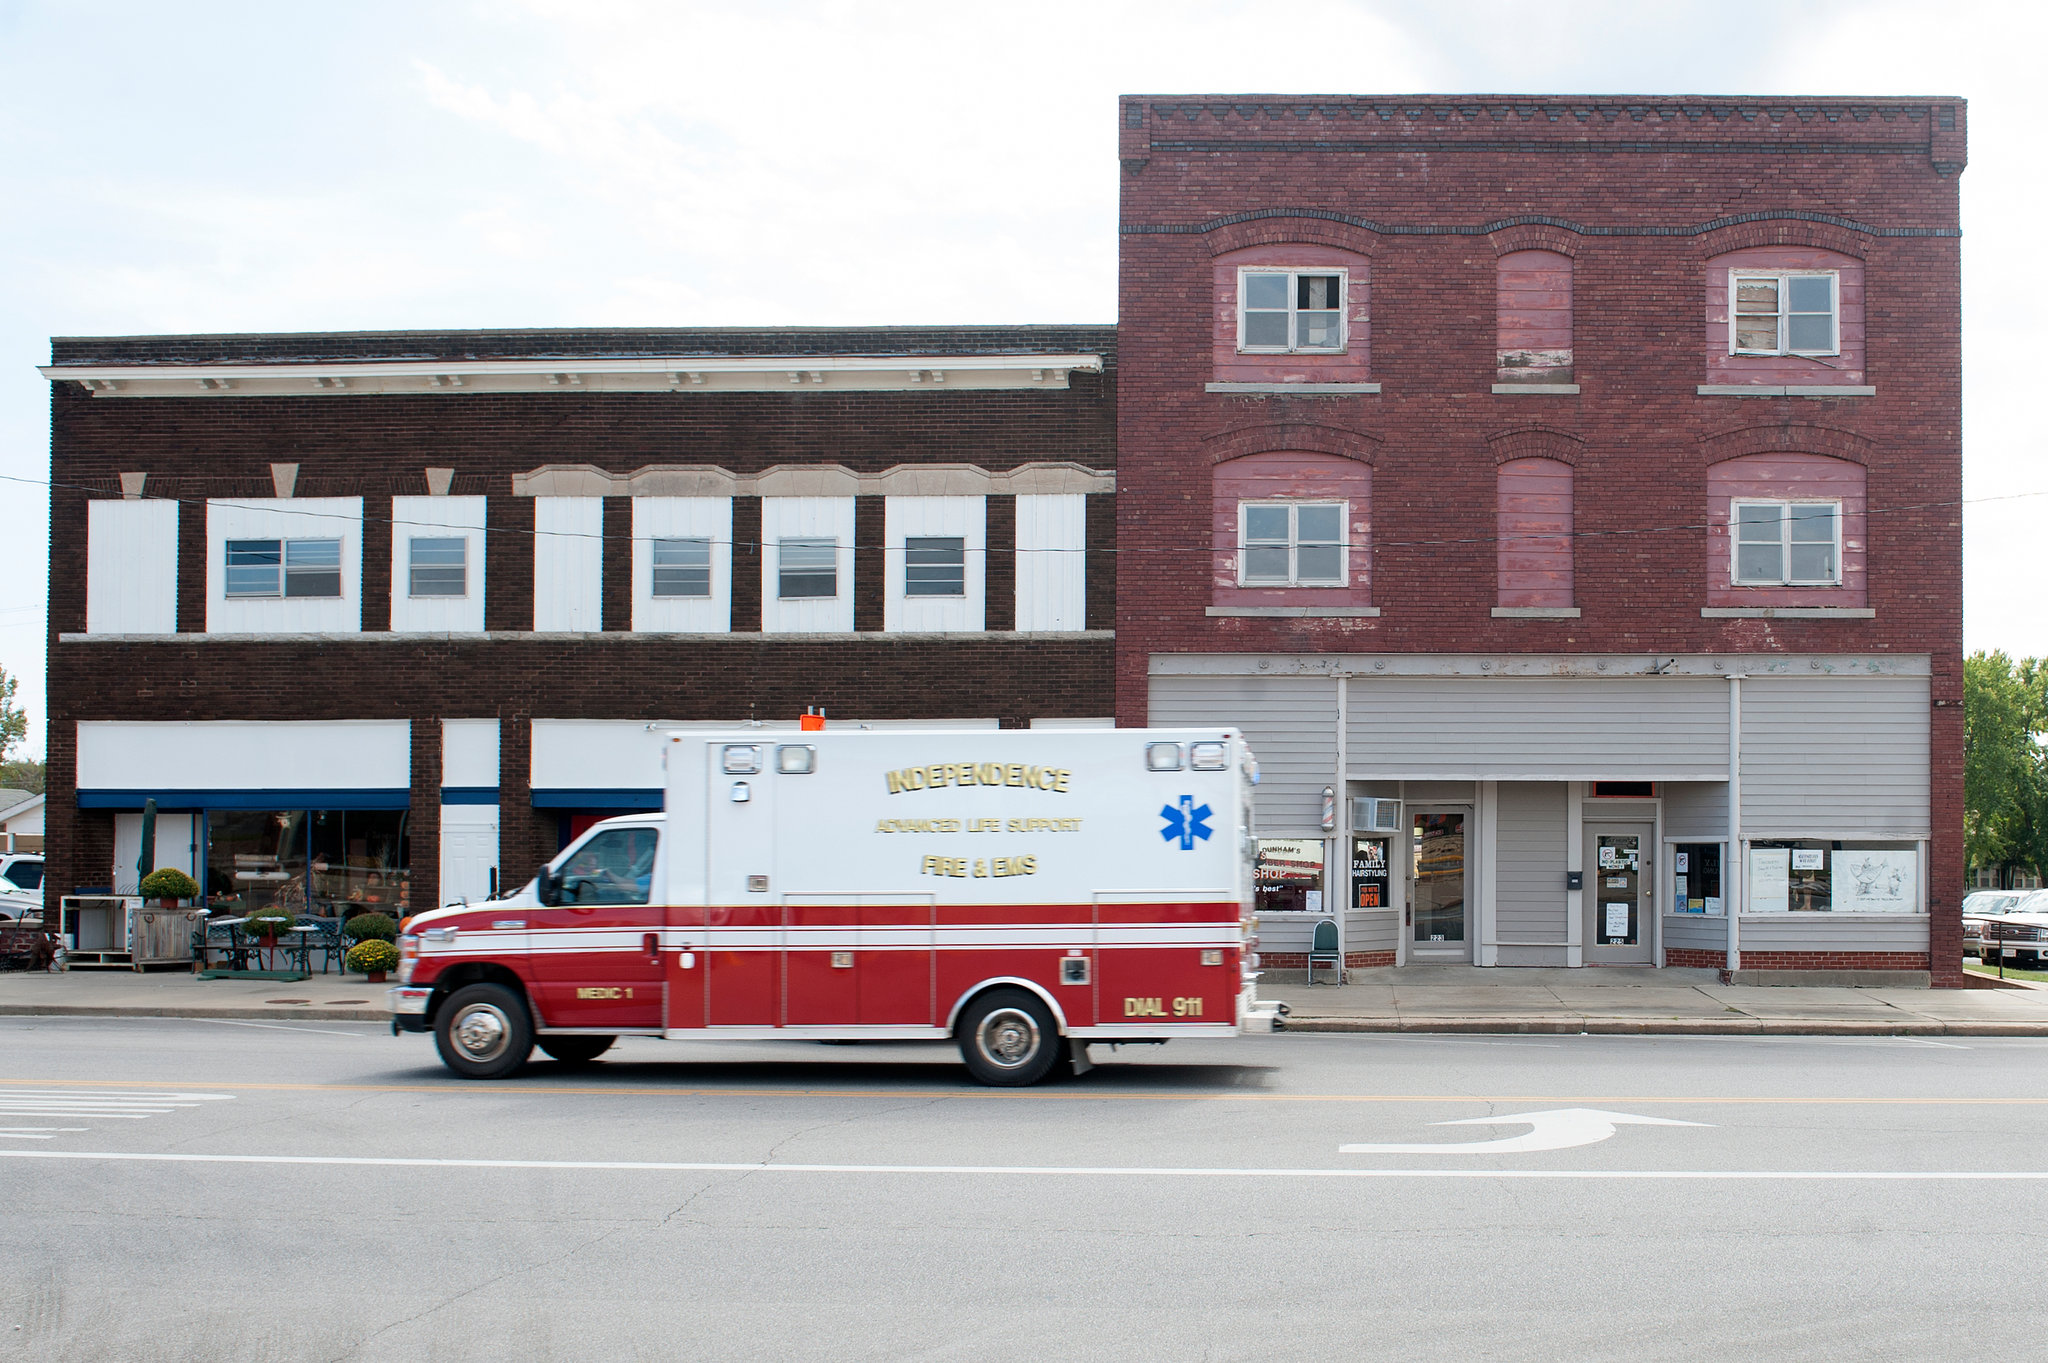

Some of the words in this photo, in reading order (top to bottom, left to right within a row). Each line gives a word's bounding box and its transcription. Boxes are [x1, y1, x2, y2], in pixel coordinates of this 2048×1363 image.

[885, 762, 1072, 795] INDEPENDENCE
[875, 818, 961, 833] ADVANCED
[967, 818, 1001, 833] LIFE
[1006, 817, 1083, 833] SUPPORT
[1261, 846, 1301, 854] DUNHAM'S
[921, 855, 968, 877] FIRE
[973, 858, 988, 878] &
[992, 854, 1037, 878] EMS
[1353, 860, 1386, 868] FAMILY
[1252, 868, 1286, 879] SHOP
[1352, 869, 1388, 877] HAIRSTYLING
[1360, 893, 1379, 907] OPEN
[576, 987, 622, 999] MEDIC
[624, 987, 633, 999] 1
[1124, 997, 1169, 1017] DIAL
[1172, 997, 1203, 1017] 911
